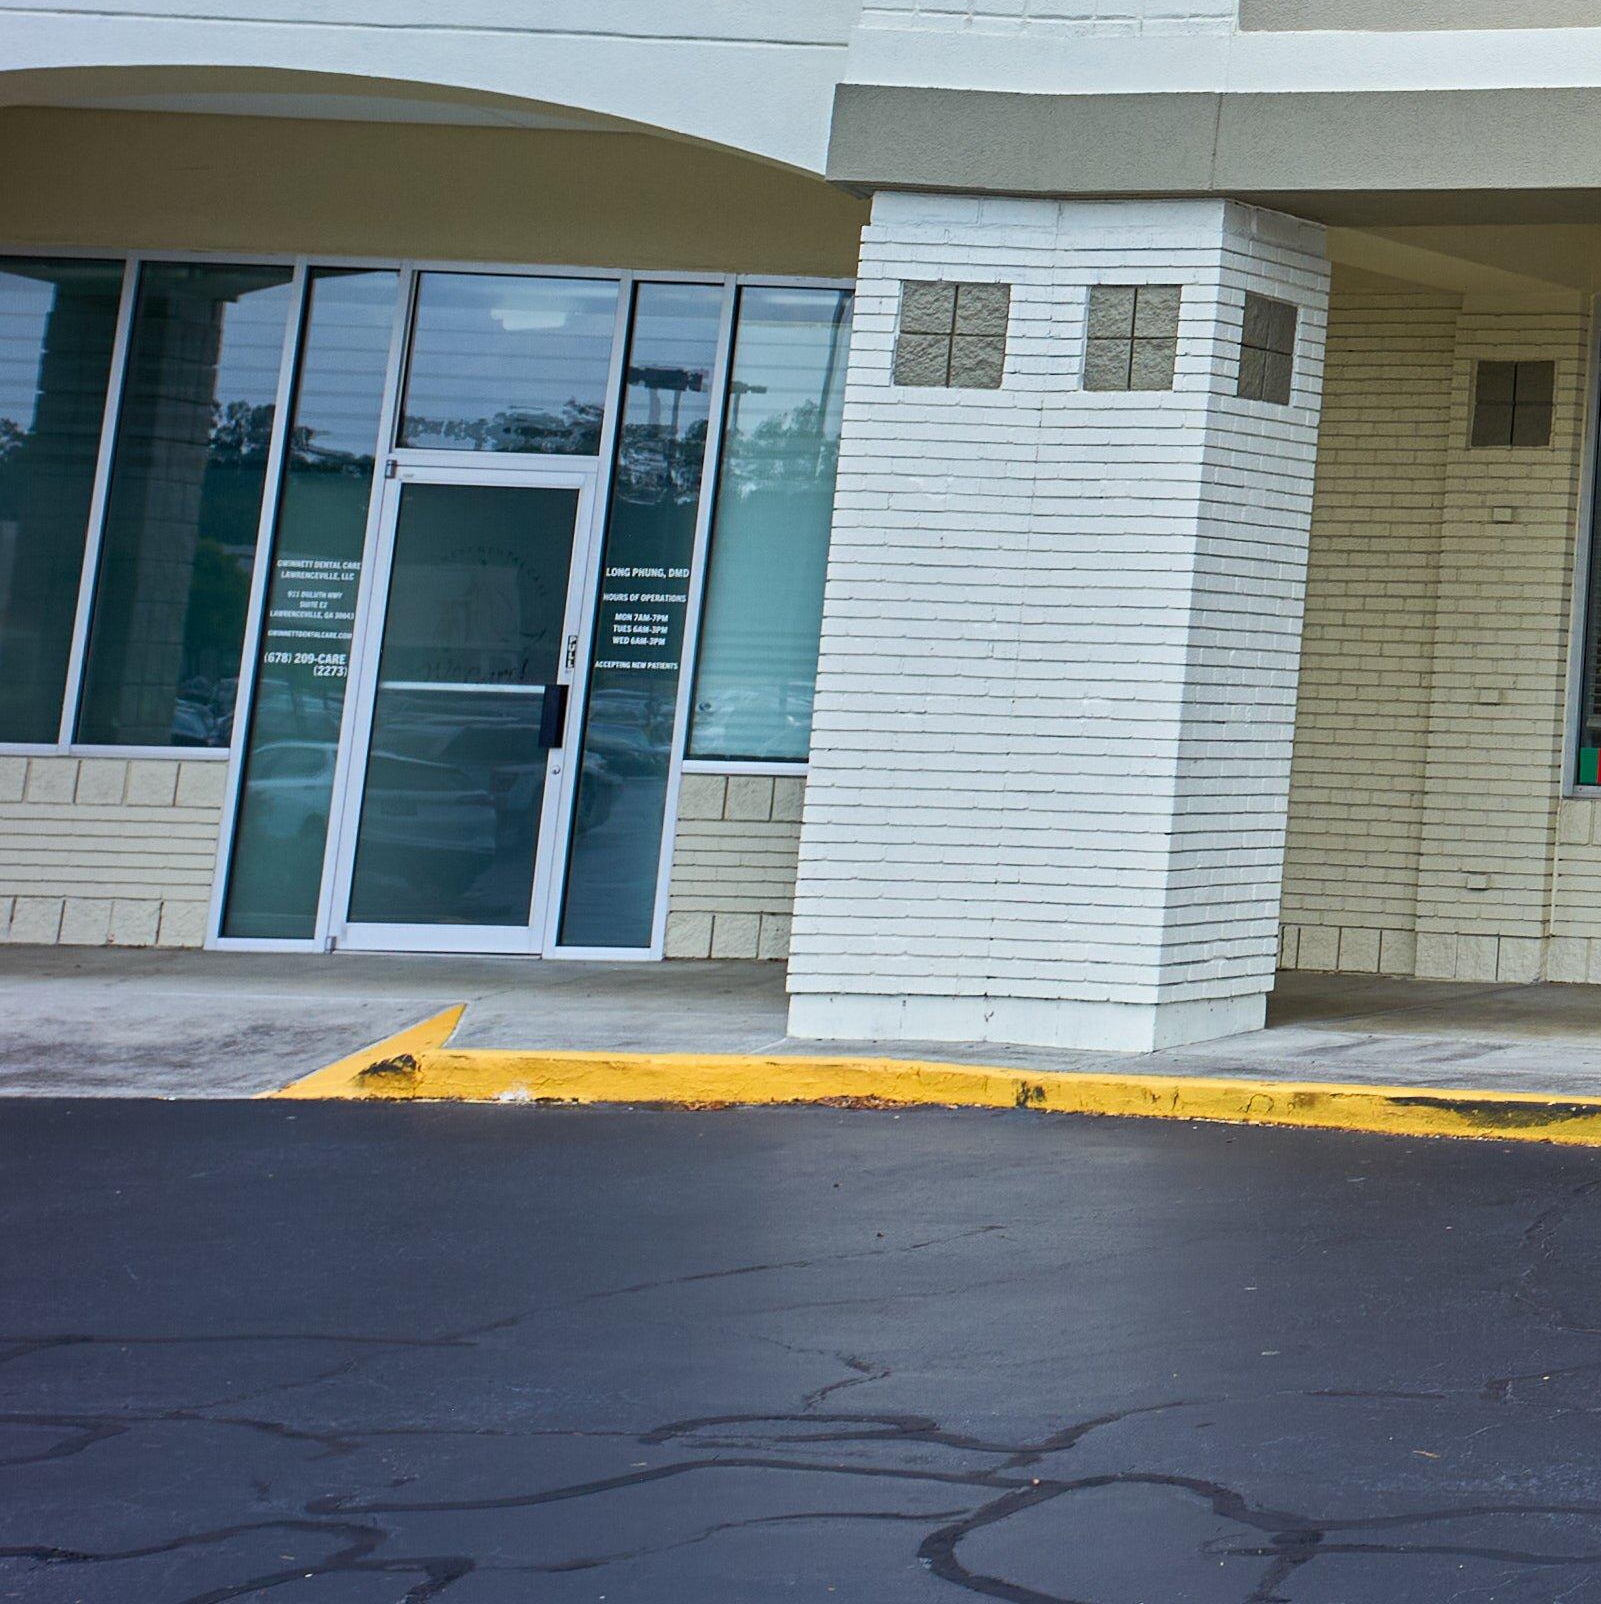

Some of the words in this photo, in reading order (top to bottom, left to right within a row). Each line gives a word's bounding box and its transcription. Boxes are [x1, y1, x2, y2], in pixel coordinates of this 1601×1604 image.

[314, 560, 341, 569] DENTAL
[342, 561, 361, 570] CARE
[341, 572, 355, 581] LLC
[606, 567, 630, 577] LONG
[632, 567, 666, 578] PHUNG,
[668, 568, 690, 578] DMD
[603, 593, 628, 602] HOURS
[629, 593, 639, 602] OF
[640, 594, 687, 603] OPERATIONS
[615, 613, 632, 621] MON
[613, 624, 632, 633] TUES
[612, 636, 630, 644] WED
[264, 652, 292, 664] (678)
[294, 652, 346, 665] 209-CARE
[594, 660, 630, 669] ACCEPTING
[647, 661, 679, 670] PATIENTS
[313, 665, 348, 677] (2273)
